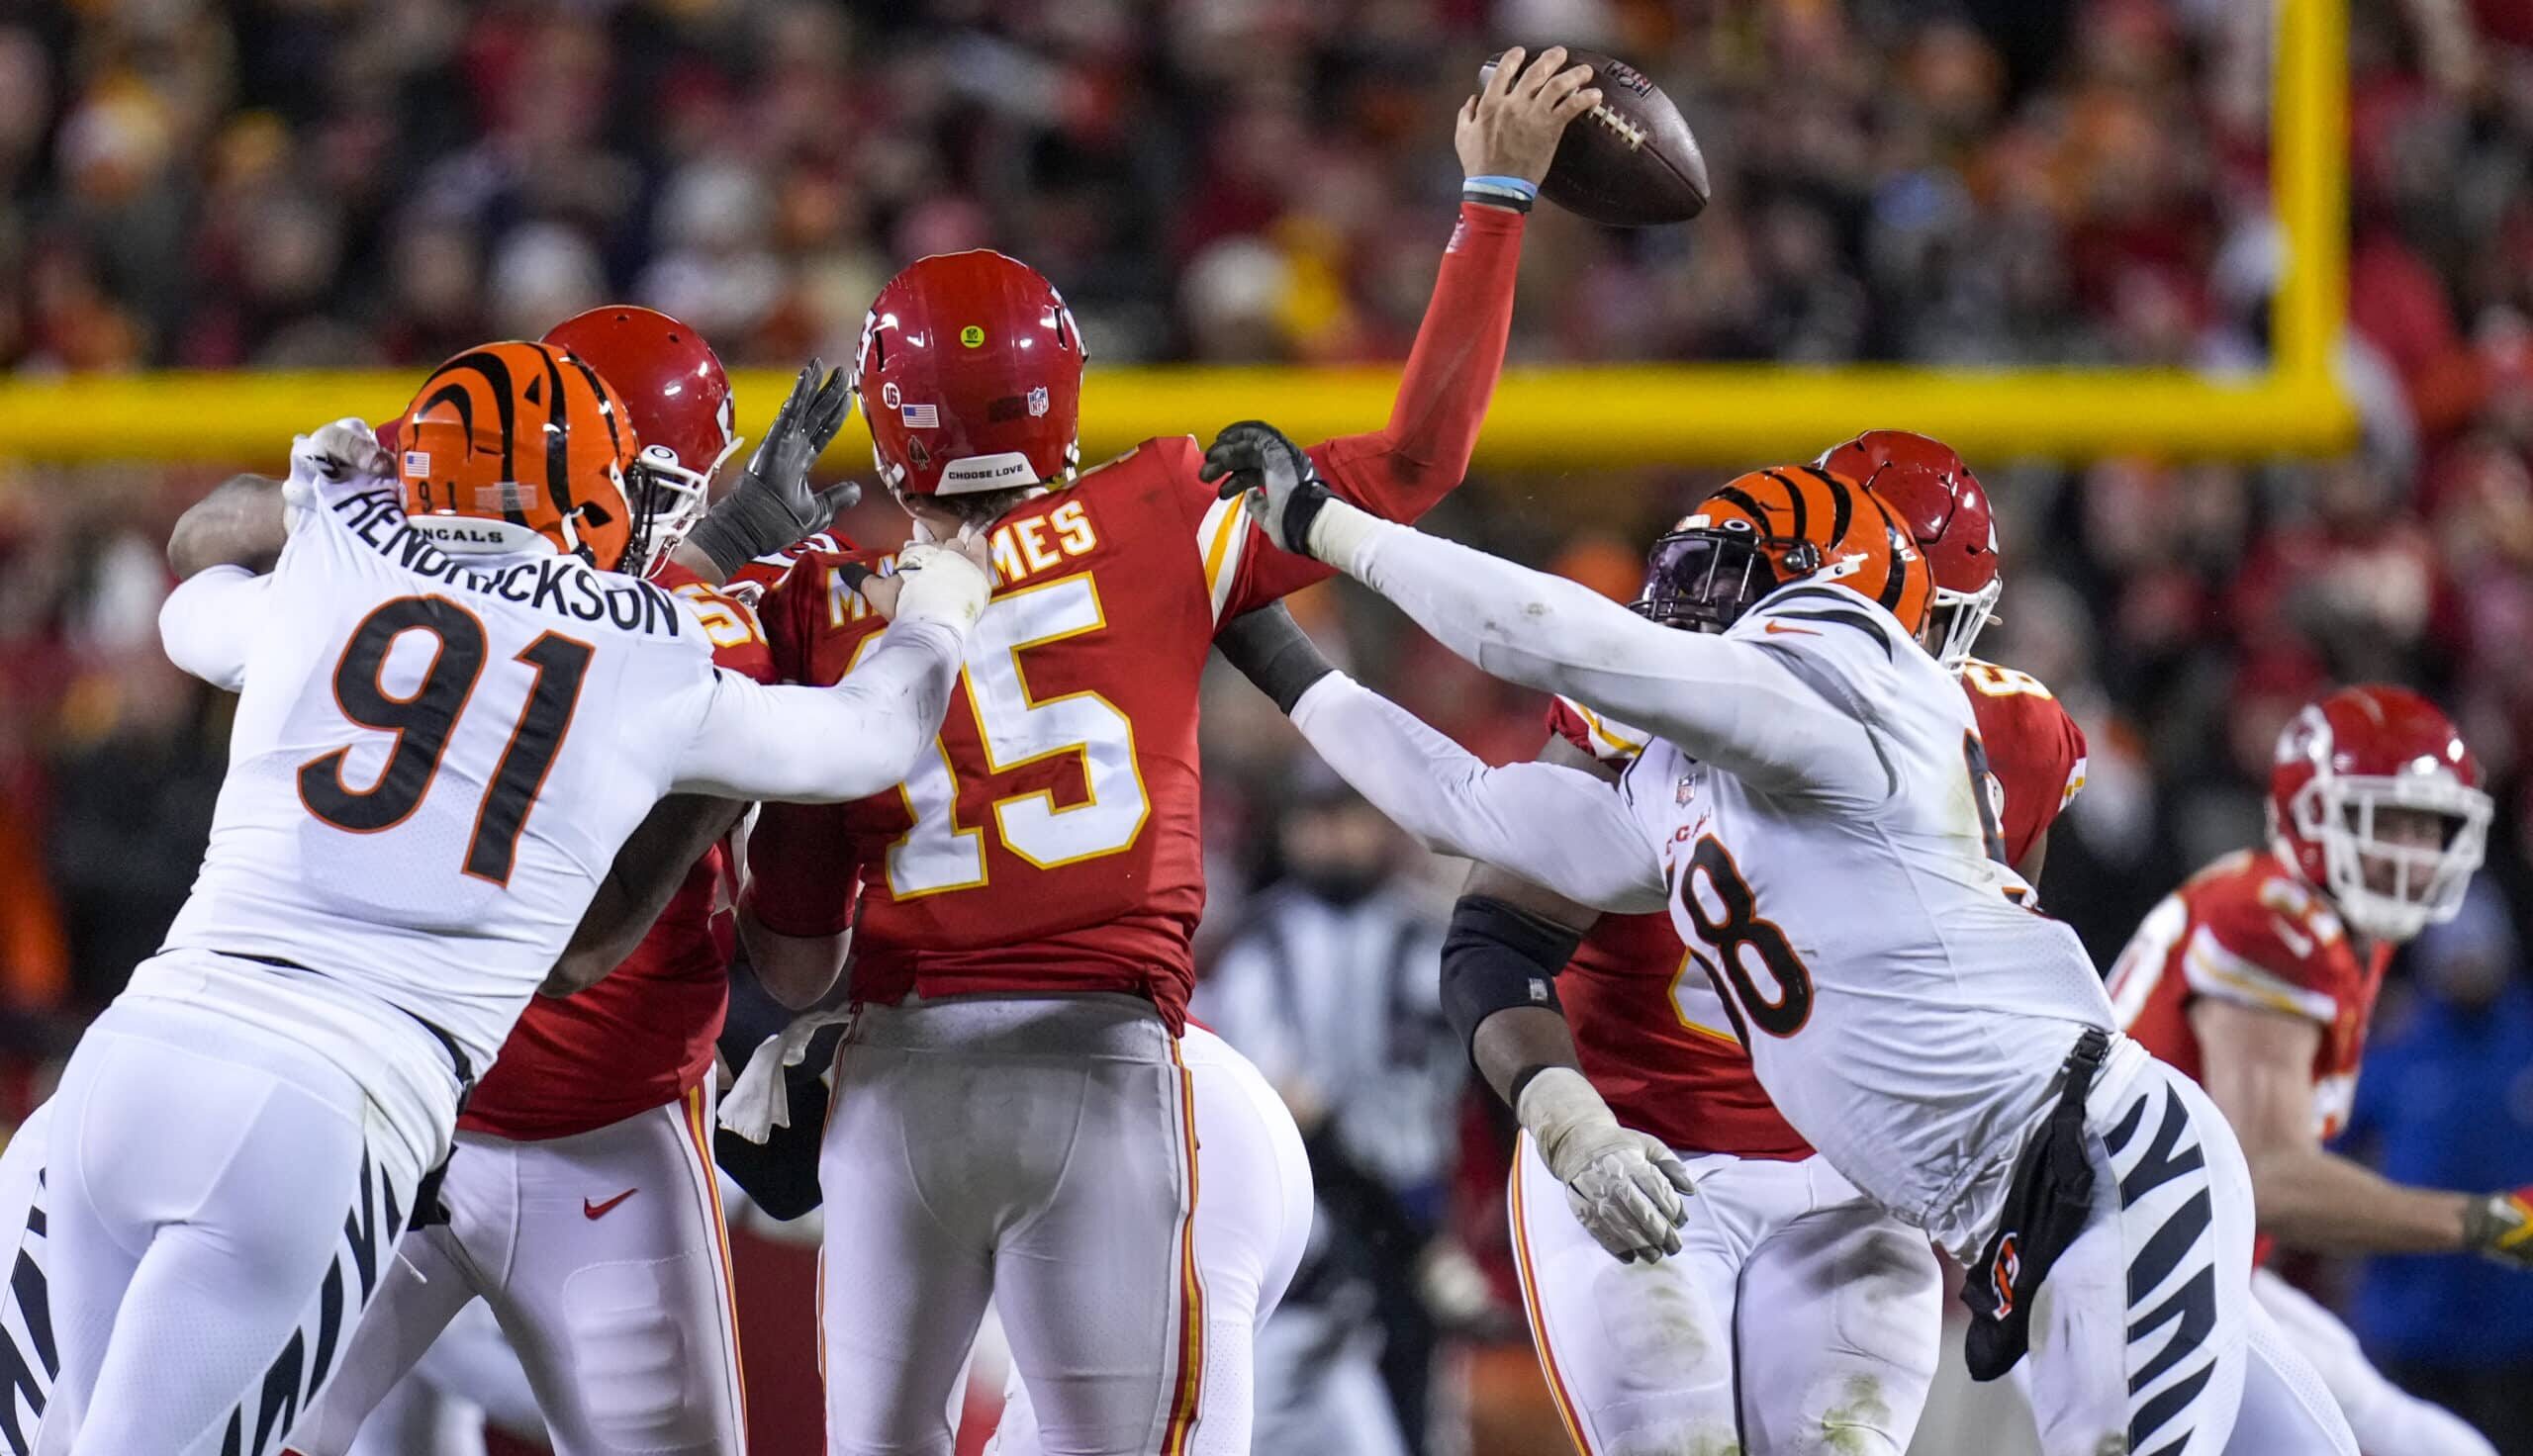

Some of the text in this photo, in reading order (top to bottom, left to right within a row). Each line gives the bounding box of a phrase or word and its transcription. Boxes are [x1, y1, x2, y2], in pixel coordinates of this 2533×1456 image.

[885, 384, 898, 406] 16
[948, 464, 1023, 480] CHOOSE LOVE
[419, 481, 456, 512] 91
[422, 528, 504, 543] NGALS
[297, 592, 596, 889] 91
[843, 571, 1151, 901] 15
[1666, 832, 1814, 1063] 8
